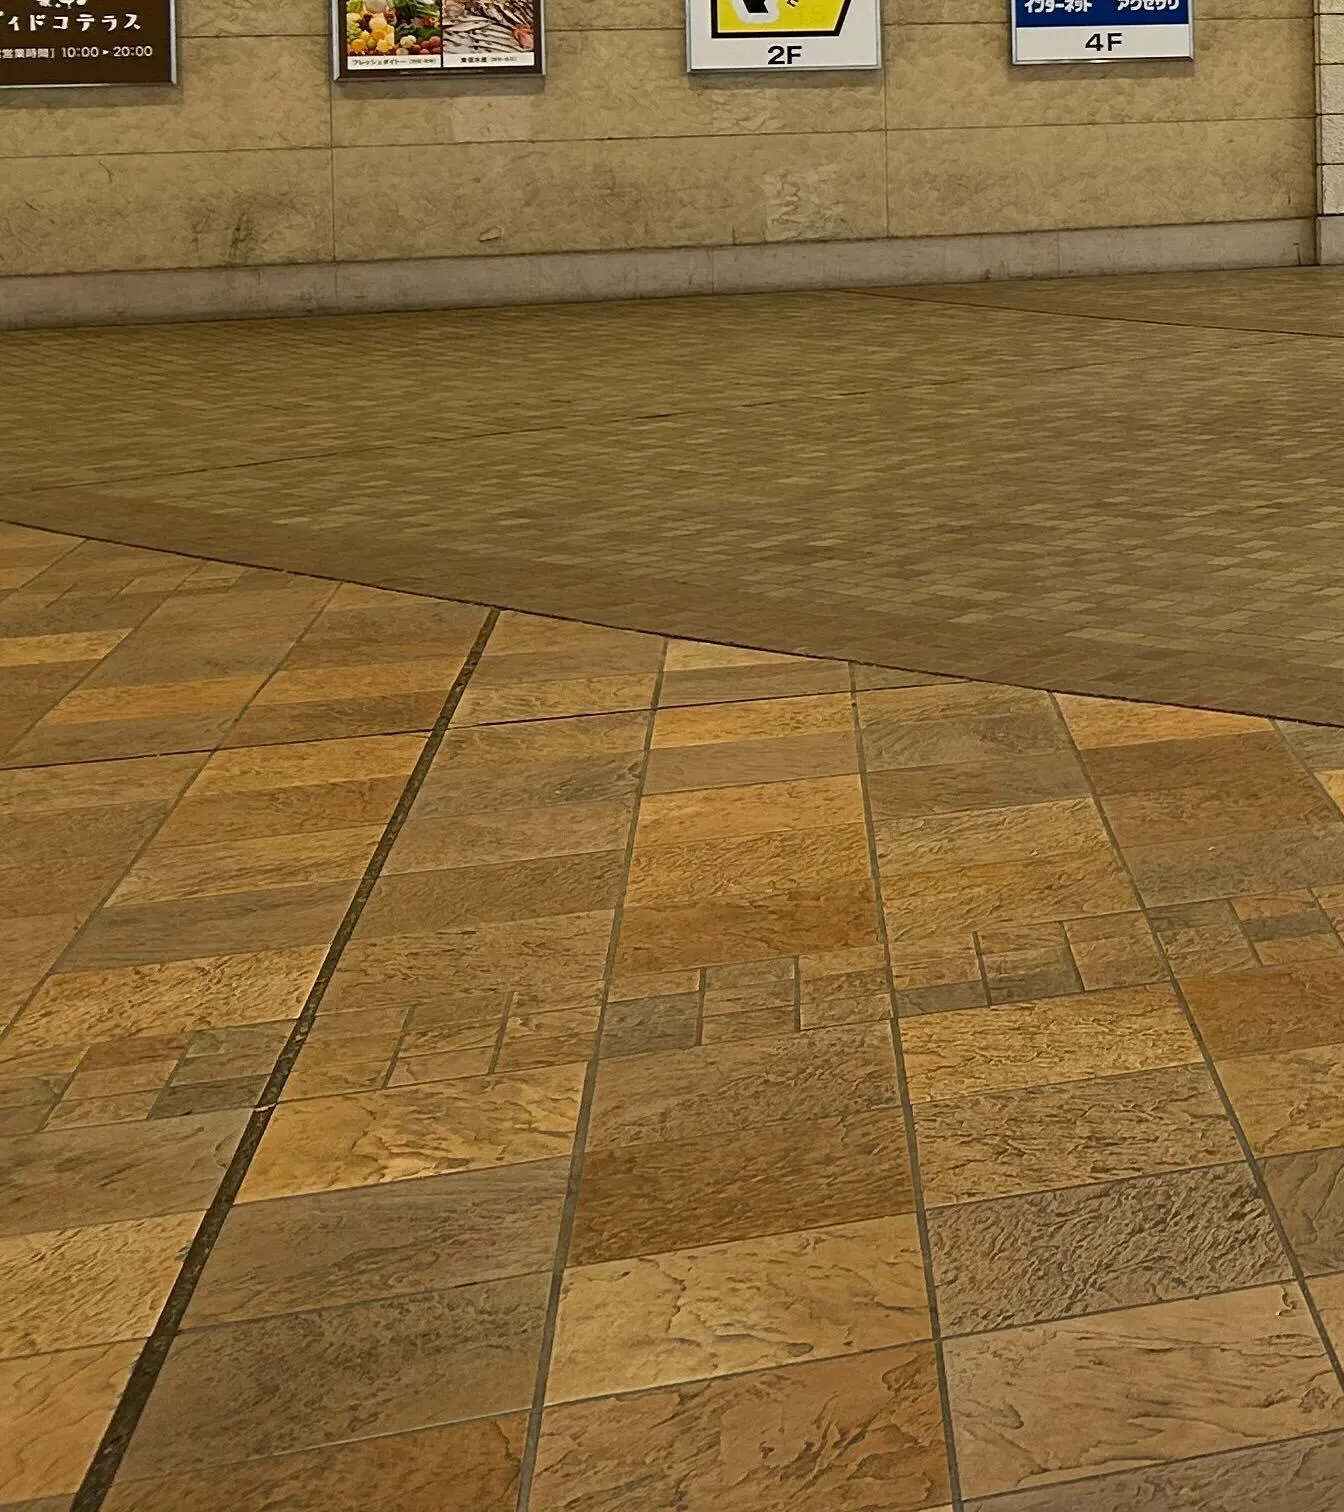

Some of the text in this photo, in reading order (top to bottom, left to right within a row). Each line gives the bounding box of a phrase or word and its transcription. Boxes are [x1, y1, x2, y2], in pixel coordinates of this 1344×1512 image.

[0, 11, 141, 32] イドコテラス
[61, 46, 99, 58] 10:00
[113, 45, 153, 57] 20:00
[1085, 32, 1122, 52] 4F
[767, 45, 802, 65] 2F
